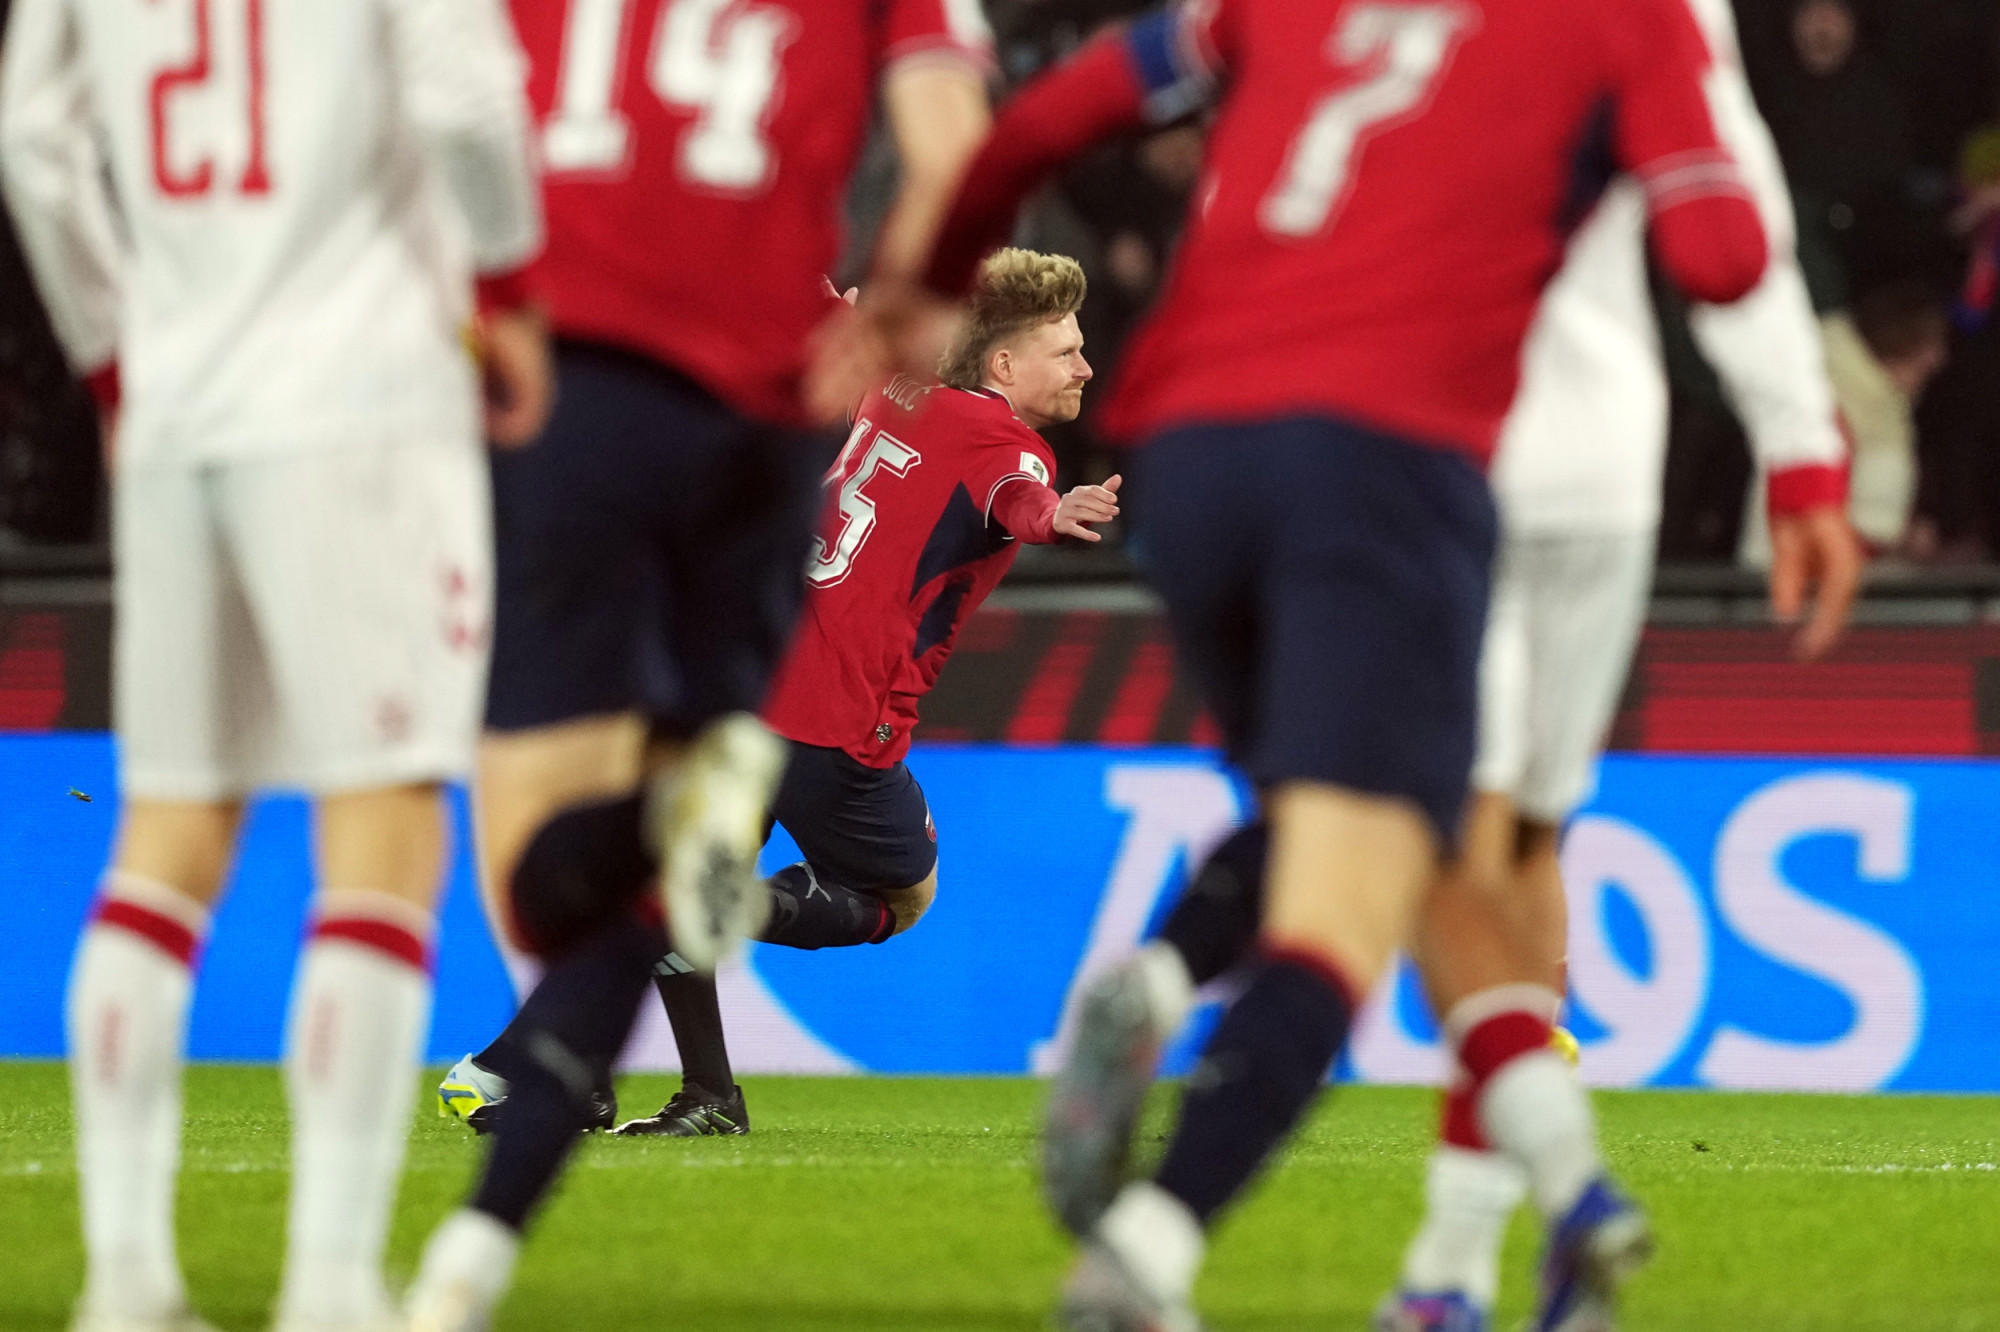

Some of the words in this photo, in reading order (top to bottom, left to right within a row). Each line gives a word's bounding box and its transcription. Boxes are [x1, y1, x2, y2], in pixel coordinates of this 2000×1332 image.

[147, 0, 273, 196] 21
[540, 0, 790, 190] 14
[1255, 3, 1484, 241] 7
